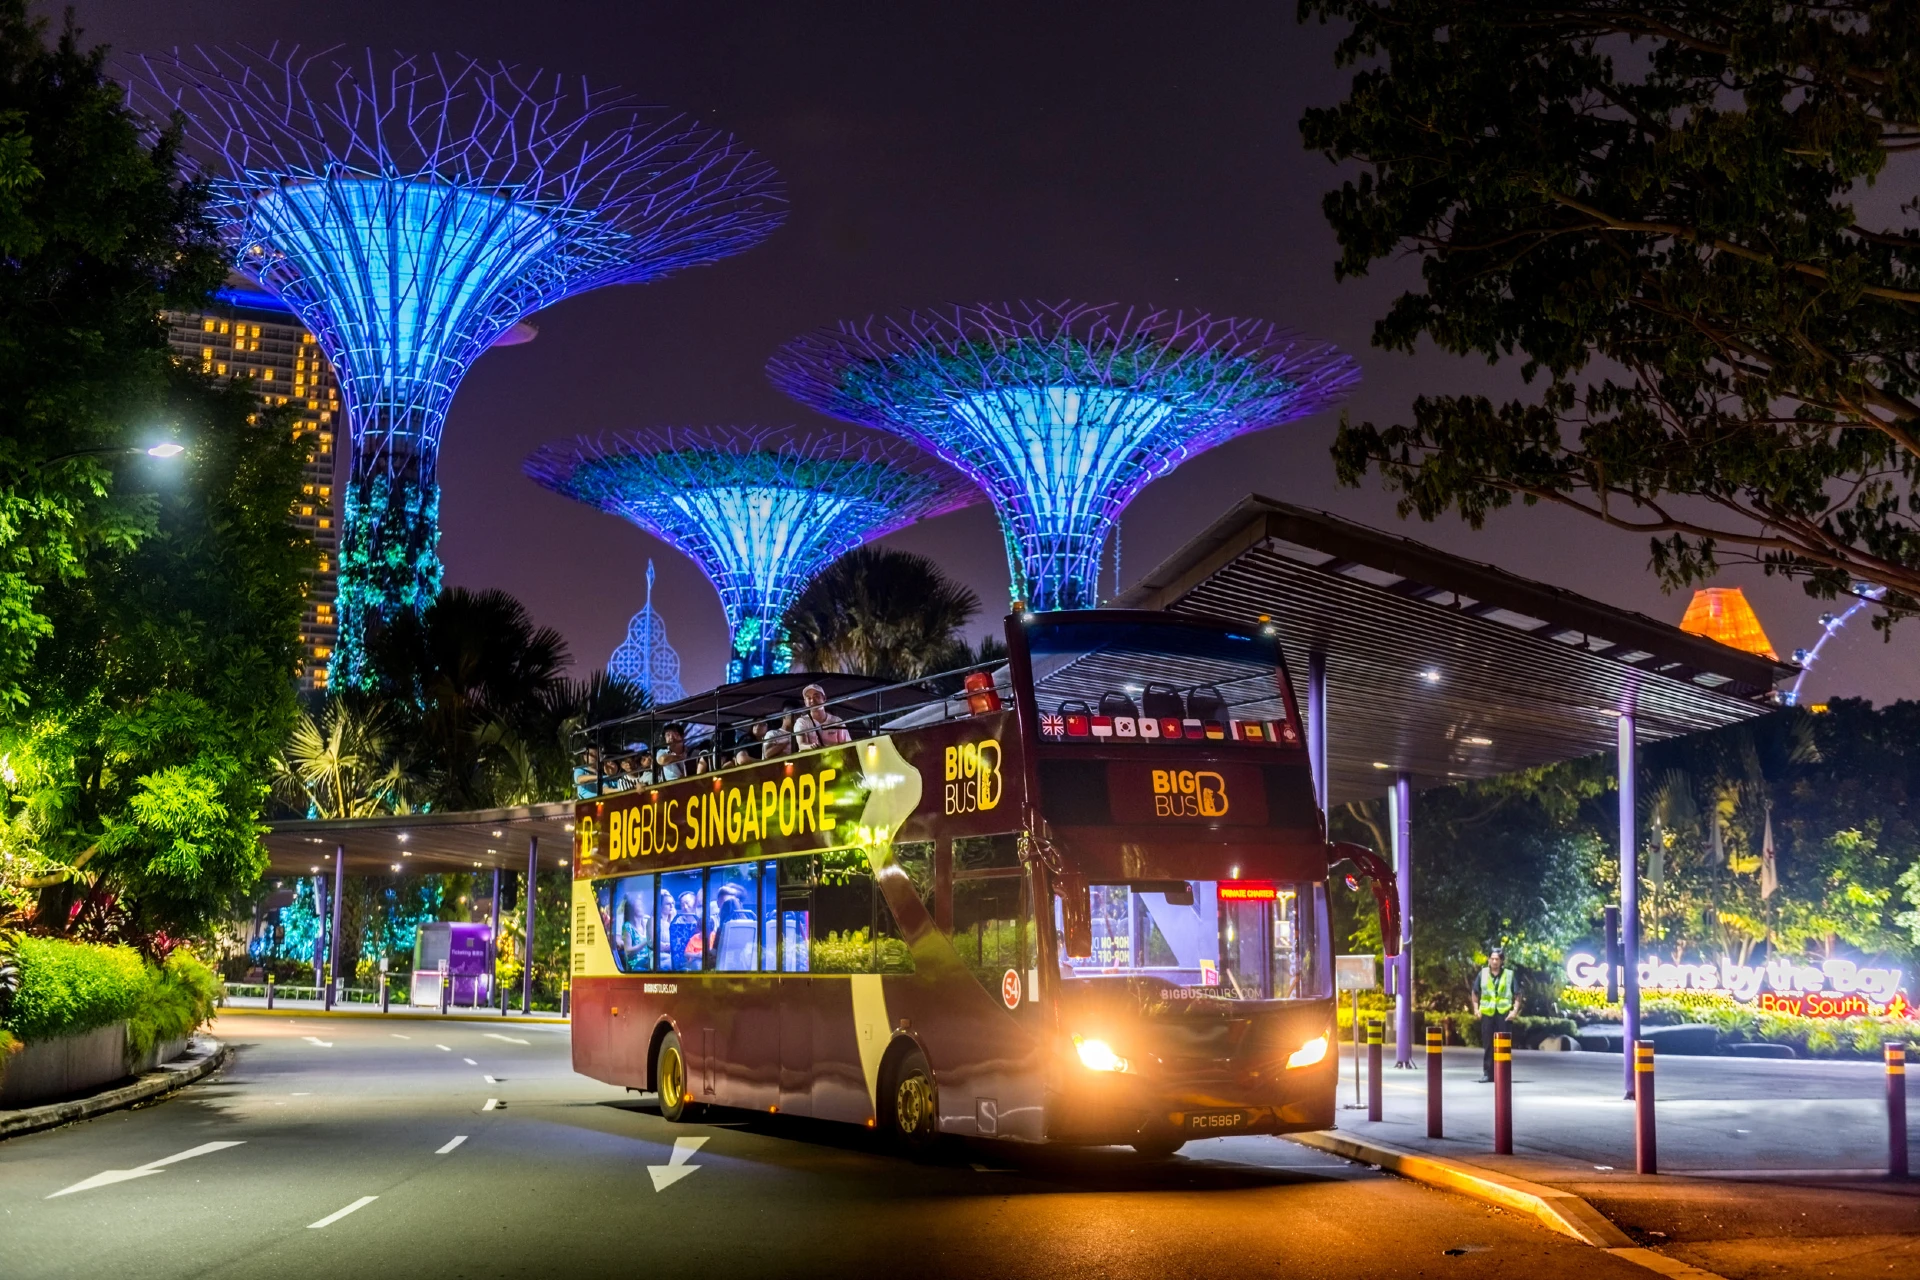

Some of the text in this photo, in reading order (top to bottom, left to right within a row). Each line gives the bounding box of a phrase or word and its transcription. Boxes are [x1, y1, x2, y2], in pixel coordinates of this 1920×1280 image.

[946, 742, 977, 781] BIG
[1152, 769, 1195, 794] BIG
[945, 781, 976, 815] BUS
[1155, 795, 1199, 816] BUS
[609, 768, 836, 861] BIGBUS SINGAPORE
[1221, 889, 1275, 898] PRIVATE CHARTER
[1005, 977, 1018, 999] 54
[1567, 953, 1902, 1003] Gdens by the Bay
[1161, 987, 1263, 999] BIGBUSTOURSCOM
[1762, 993, 1866, 1015] Bay South
